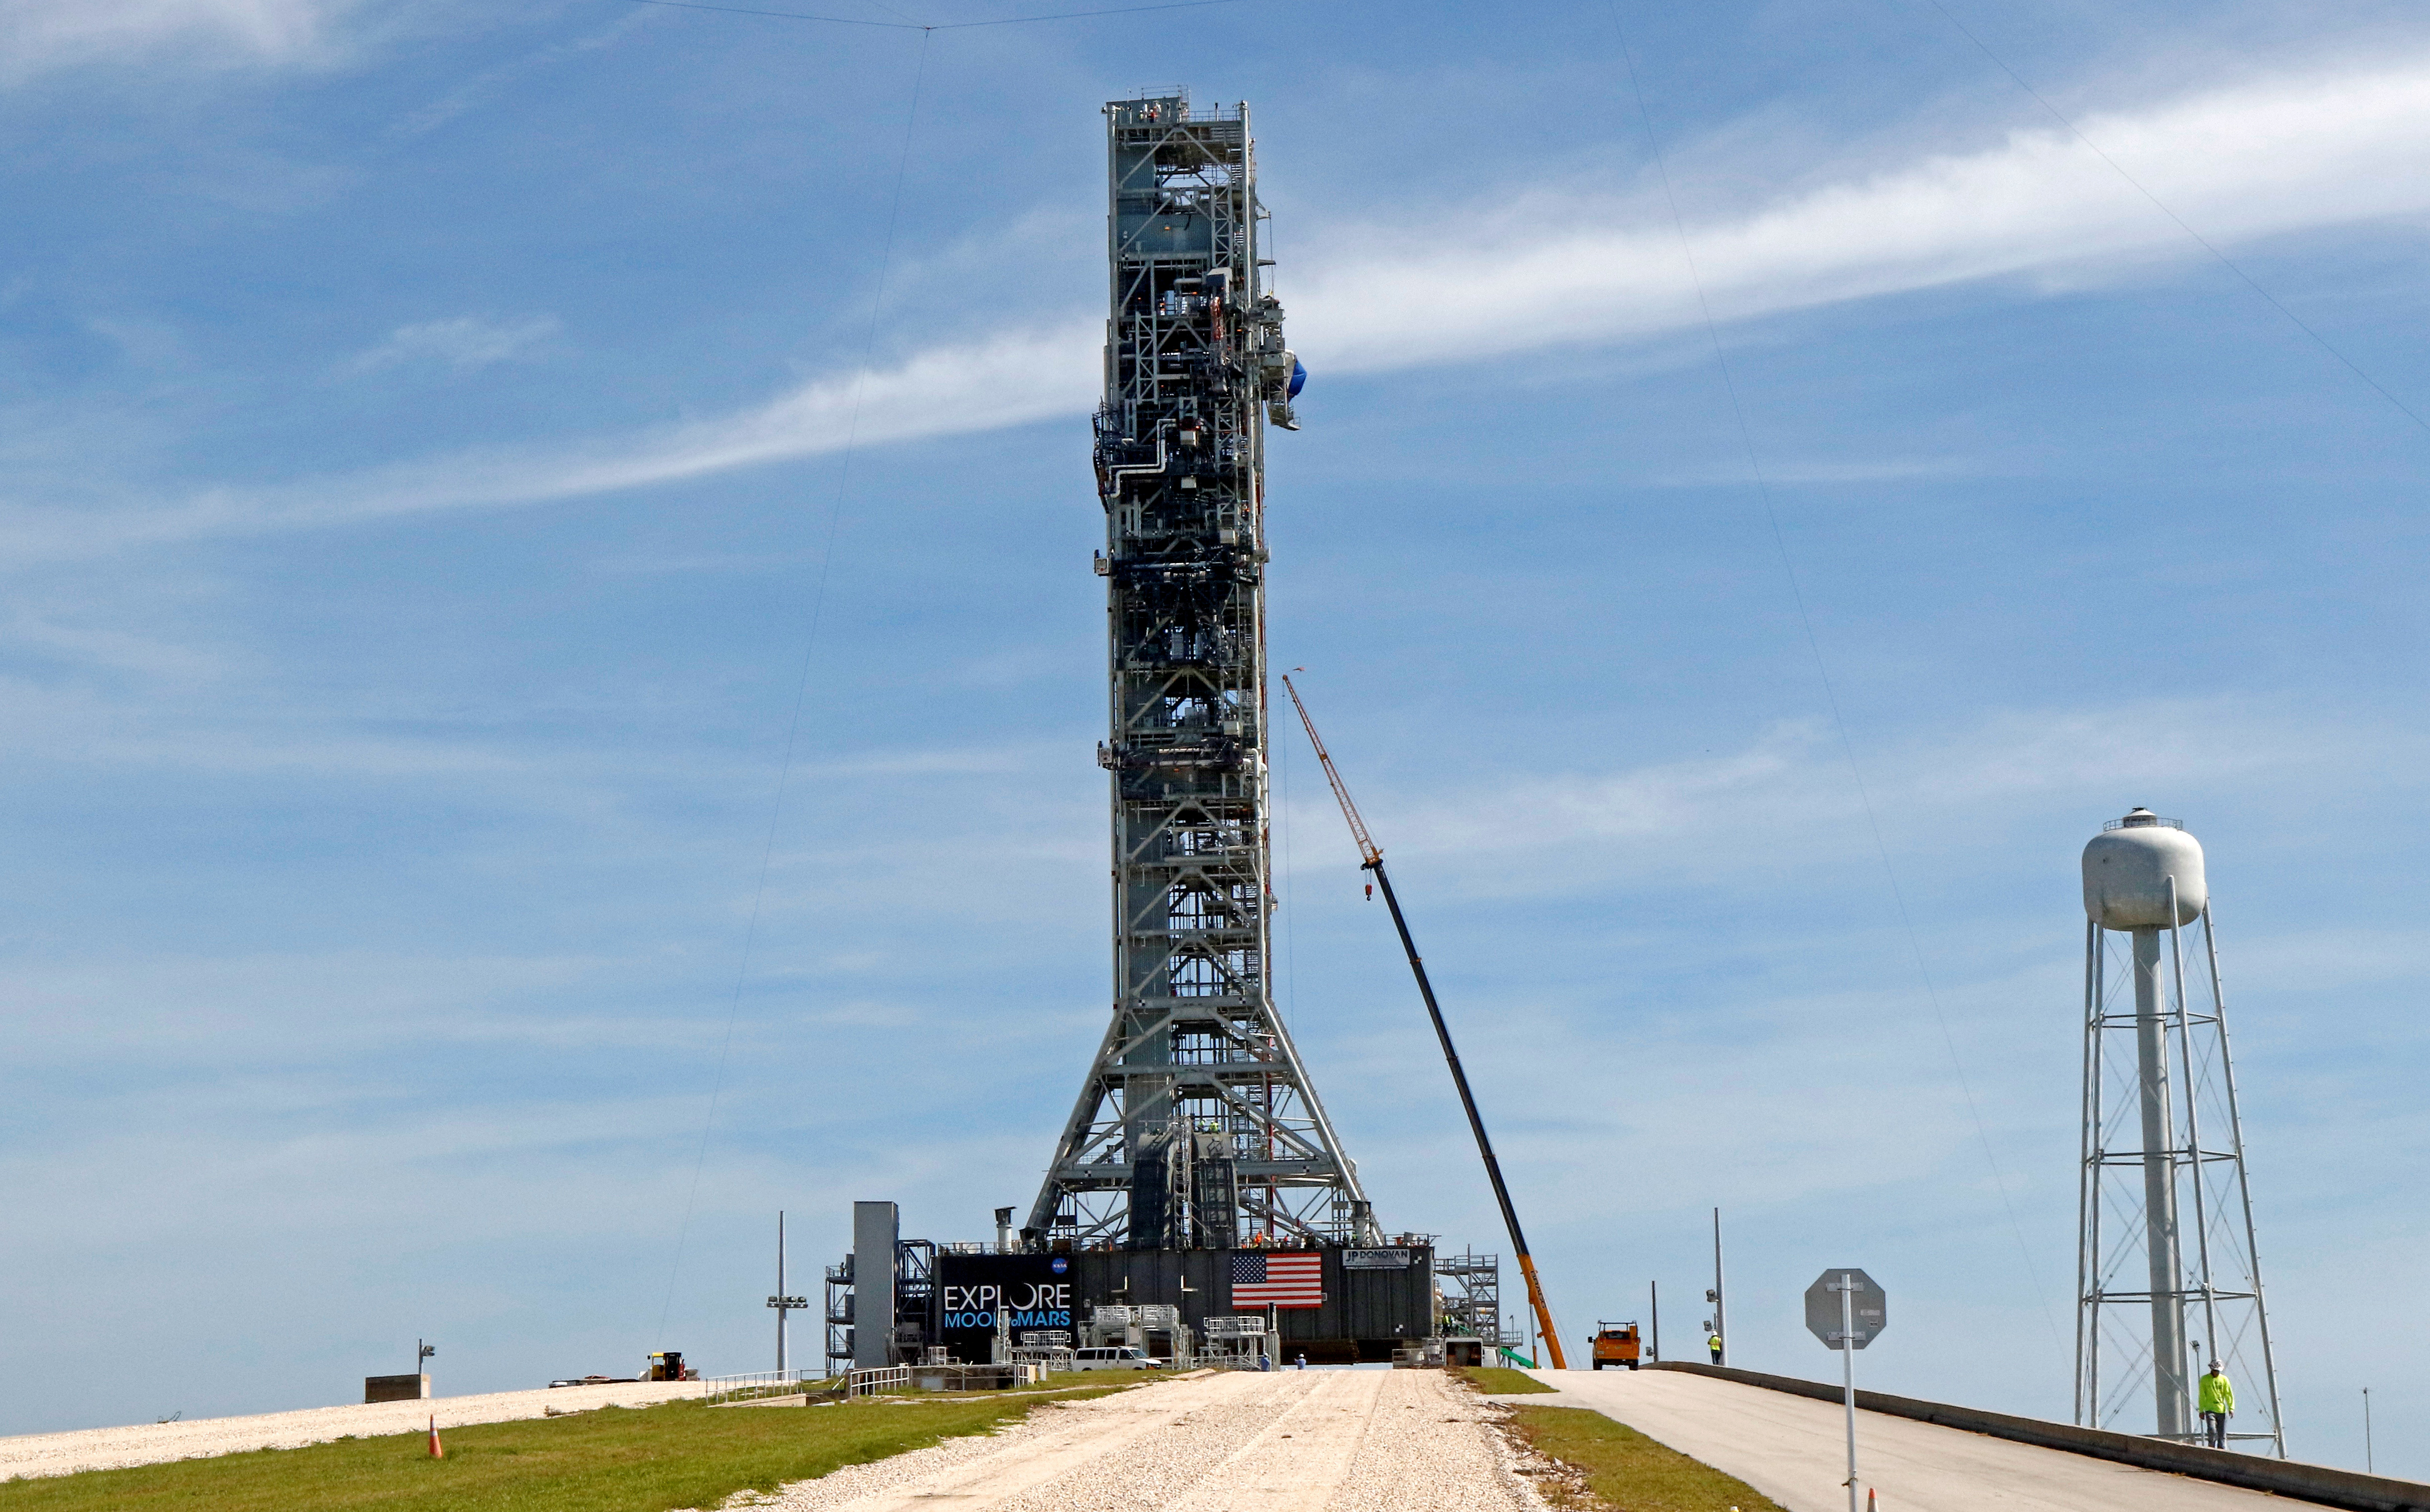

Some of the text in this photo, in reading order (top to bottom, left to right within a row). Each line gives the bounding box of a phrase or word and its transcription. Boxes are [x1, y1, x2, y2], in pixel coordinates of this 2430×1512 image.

[1345, 1250, 1407, 1262] JP DONOVAN
[944, 1282, 1070, 1311] EXPLORE
[945, 1311, 996, 1328] MOO
[1017, 1310, 1070, 1327] MARS
